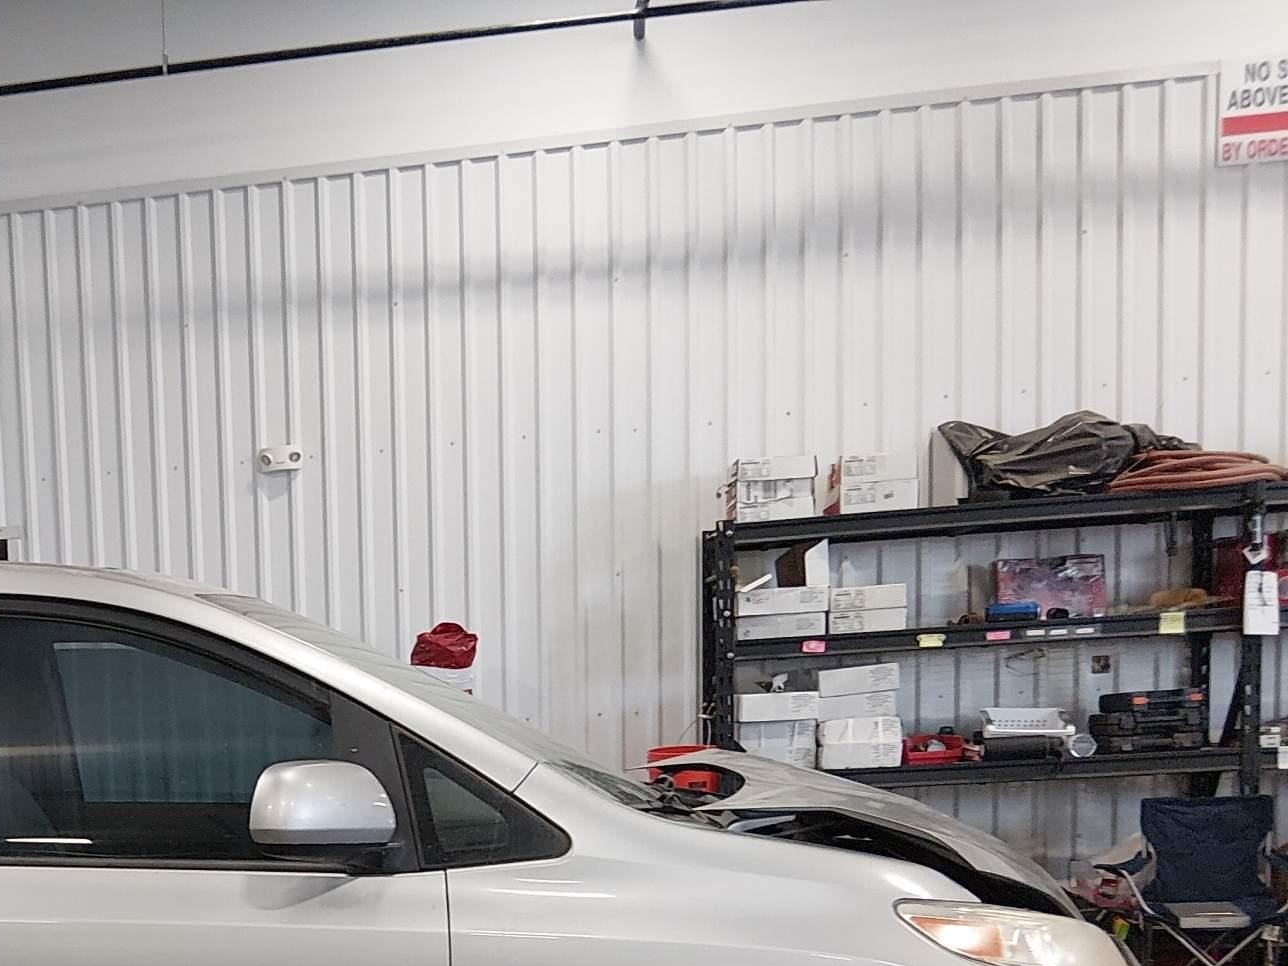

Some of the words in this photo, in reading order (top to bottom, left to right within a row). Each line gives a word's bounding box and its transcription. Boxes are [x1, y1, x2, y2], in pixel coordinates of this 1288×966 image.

[1244, 62, 1271, 83] NO
[1227, 85, 1288, 110] ABOVE
[1222, 142, 1242, 161] BY
